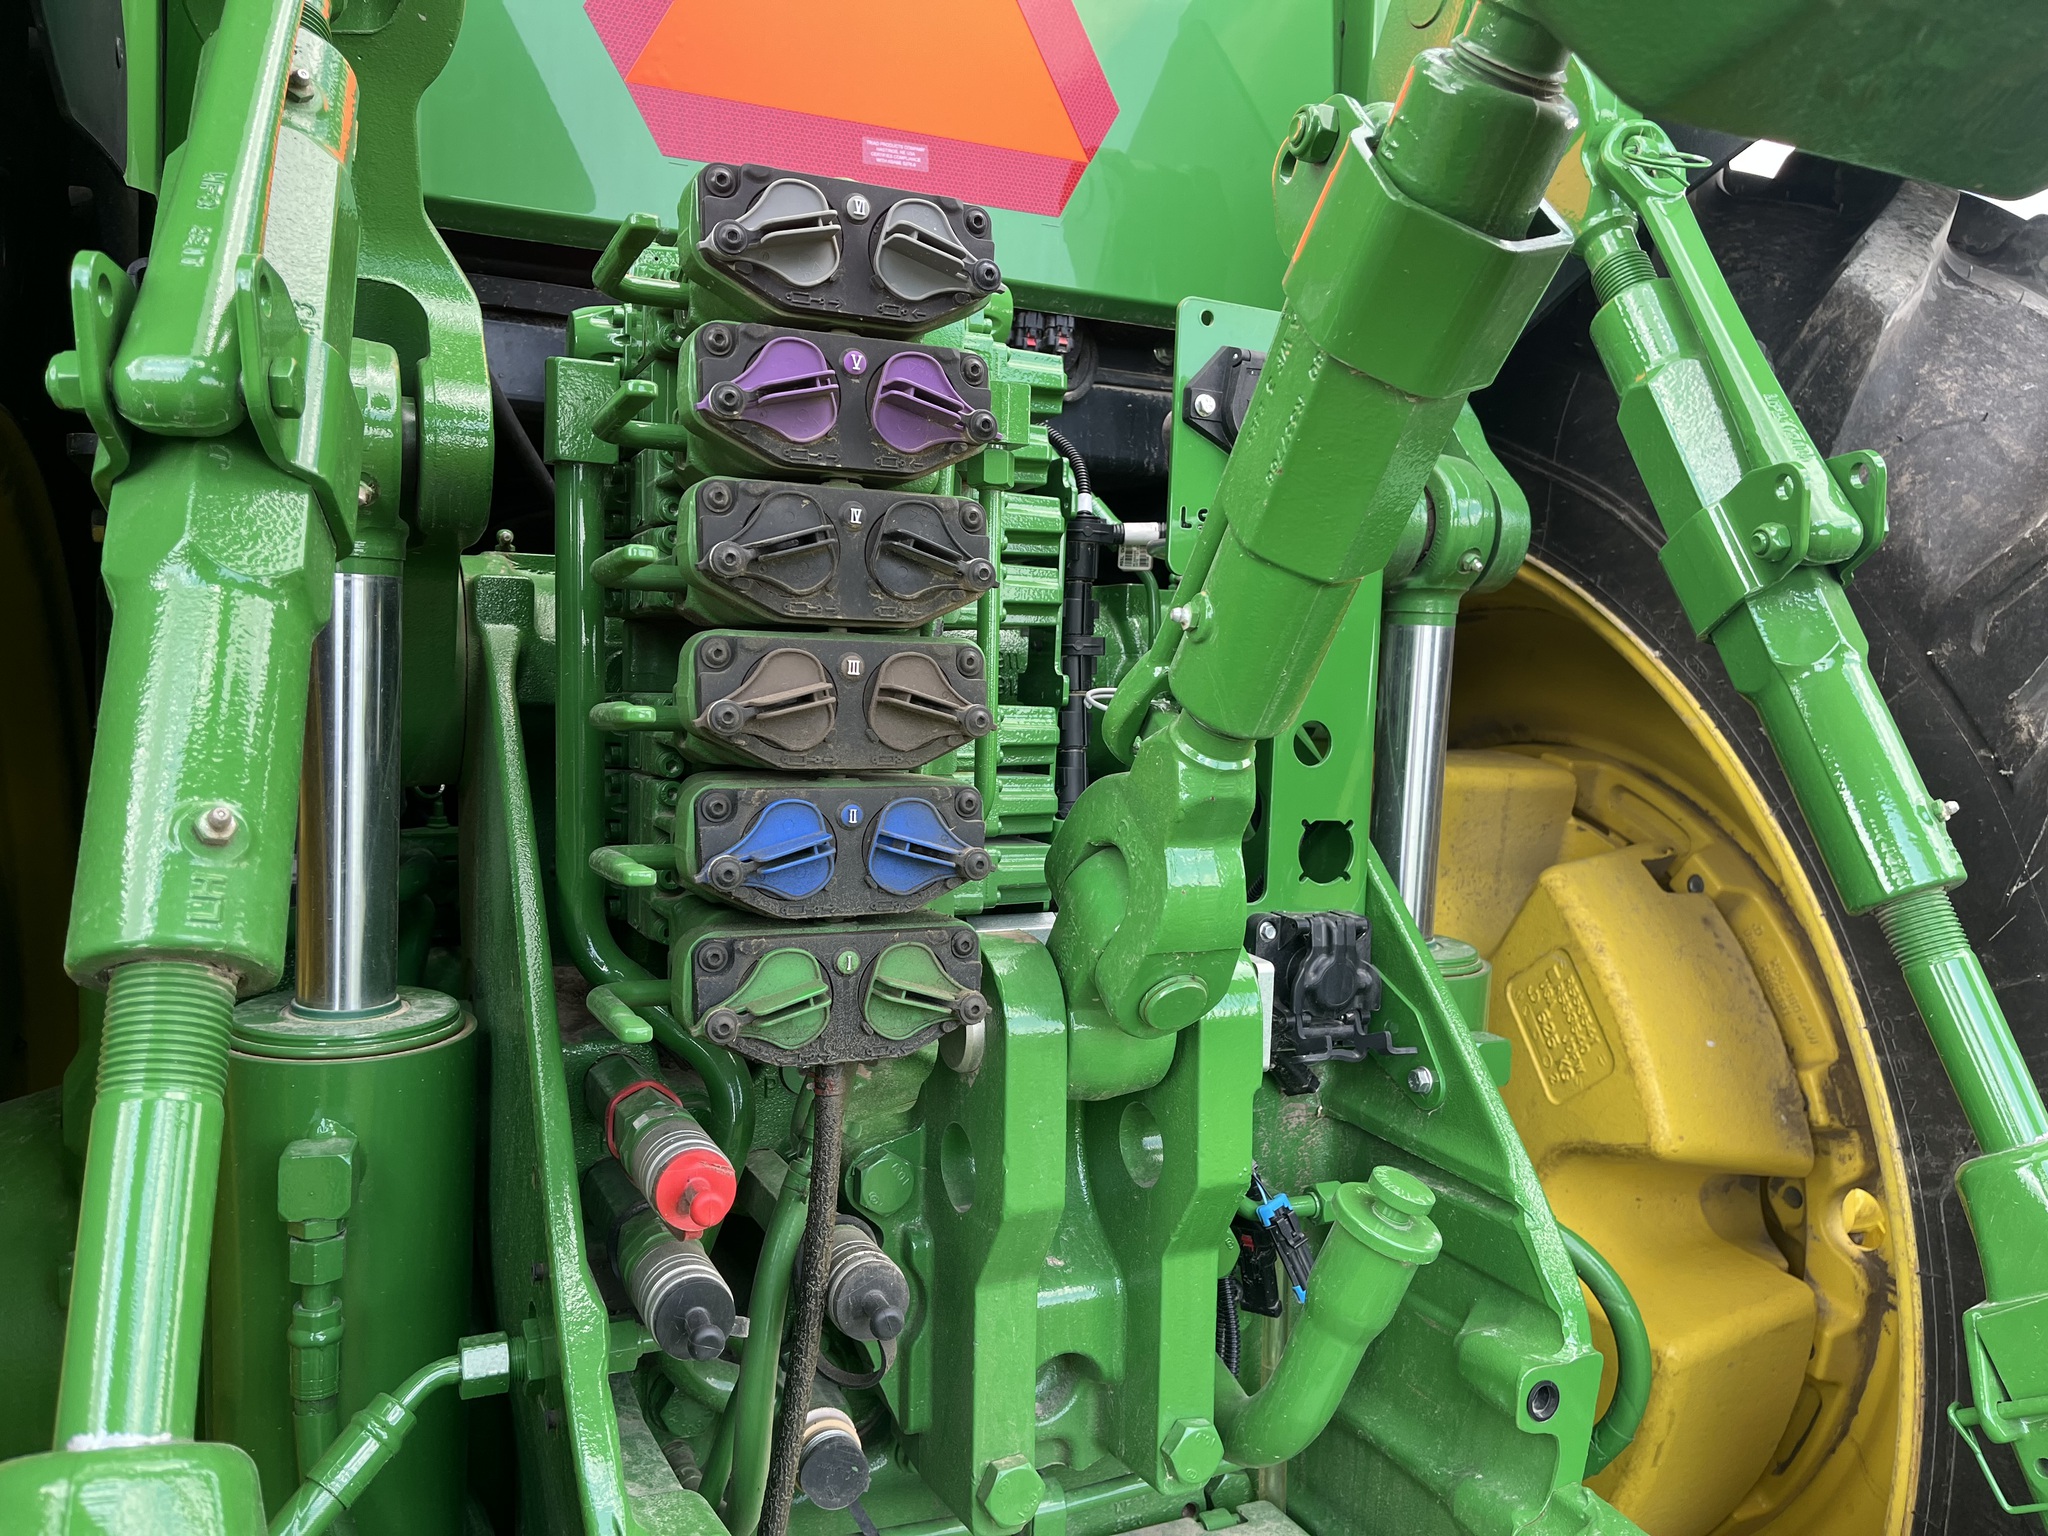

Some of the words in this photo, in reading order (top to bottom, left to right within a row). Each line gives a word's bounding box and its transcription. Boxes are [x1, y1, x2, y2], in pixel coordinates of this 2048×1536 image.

[853, 199, 867, 216] VI
[850, 354, 864, 371] V
[850, 508, 862, 525] IV
[847, 660, 861, 676] III
[848, 809, 858, 825] II
[1536, 1007, 1560, 1049] 625
